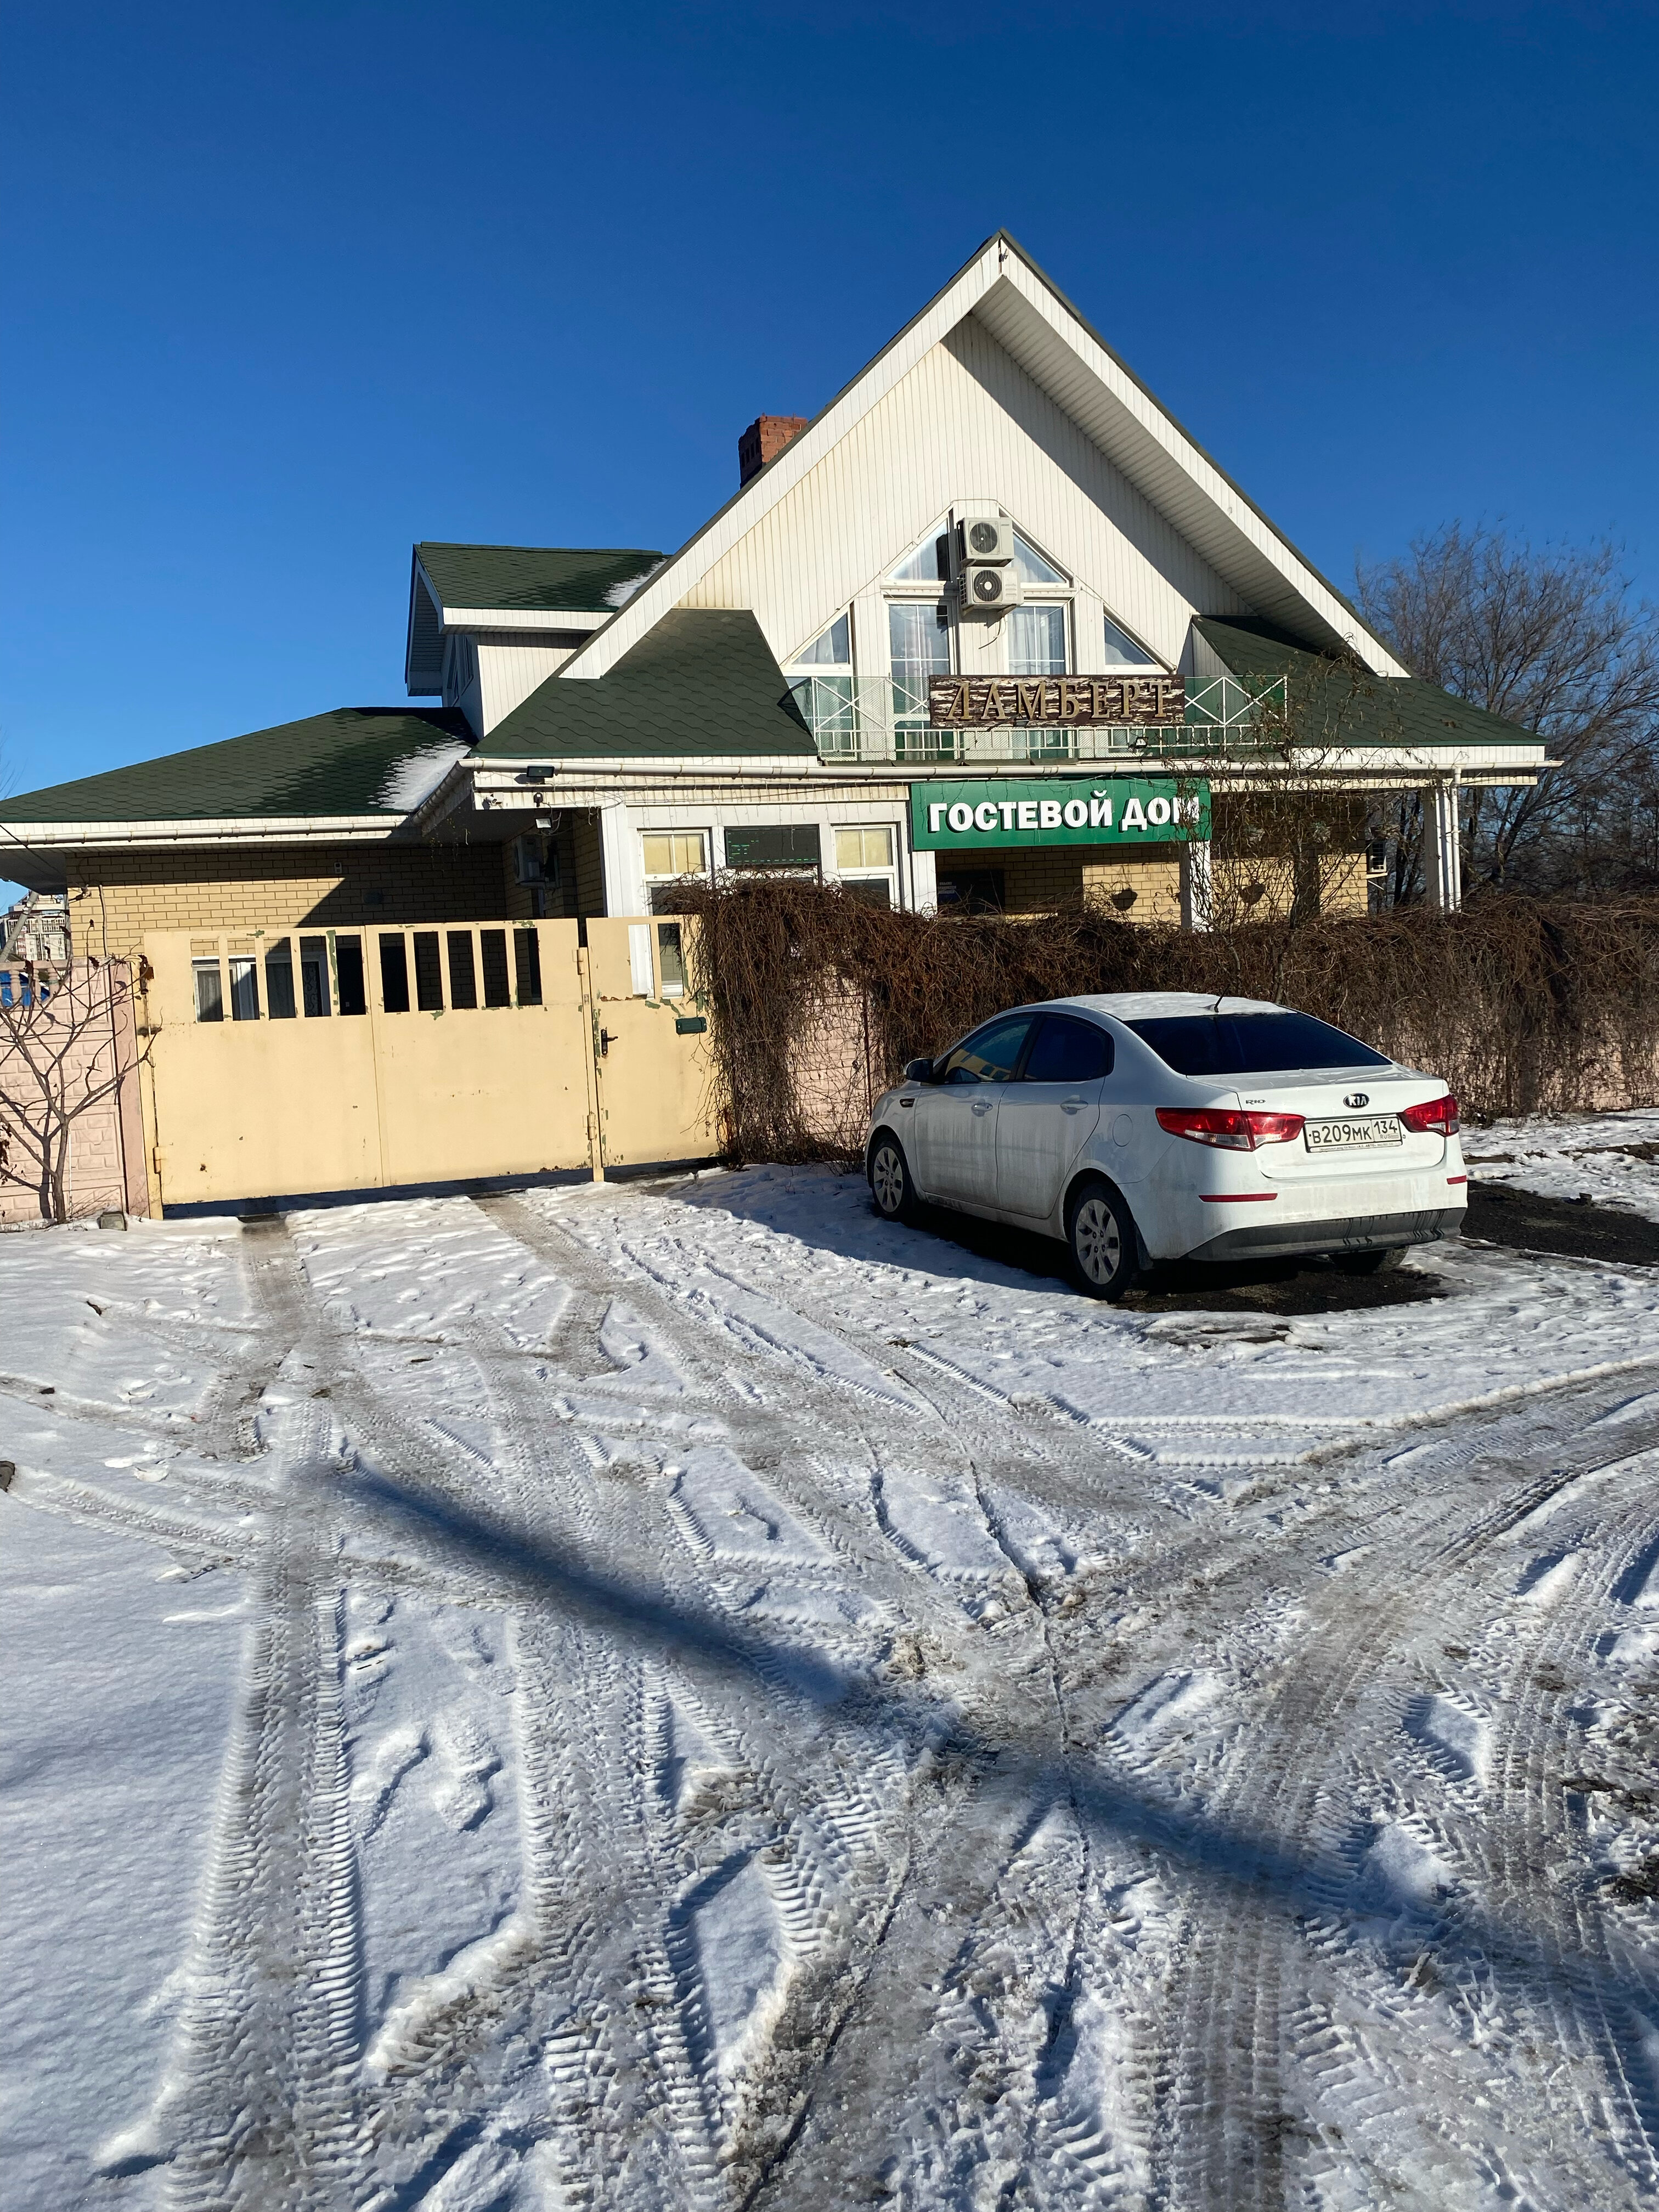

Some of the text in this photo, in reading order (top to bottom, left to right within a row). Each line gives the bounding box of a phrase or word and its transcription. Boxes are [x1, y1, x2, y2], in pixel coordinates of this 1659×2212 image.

[945, 680, 1172, 720] ЛАМБЕРТ
[929, 790, 1112, 832] ГОСТЕВОЙ
[1349, 1096, 1368, 1106] KIA
[1374, 1120, 1396, 1135] 134
